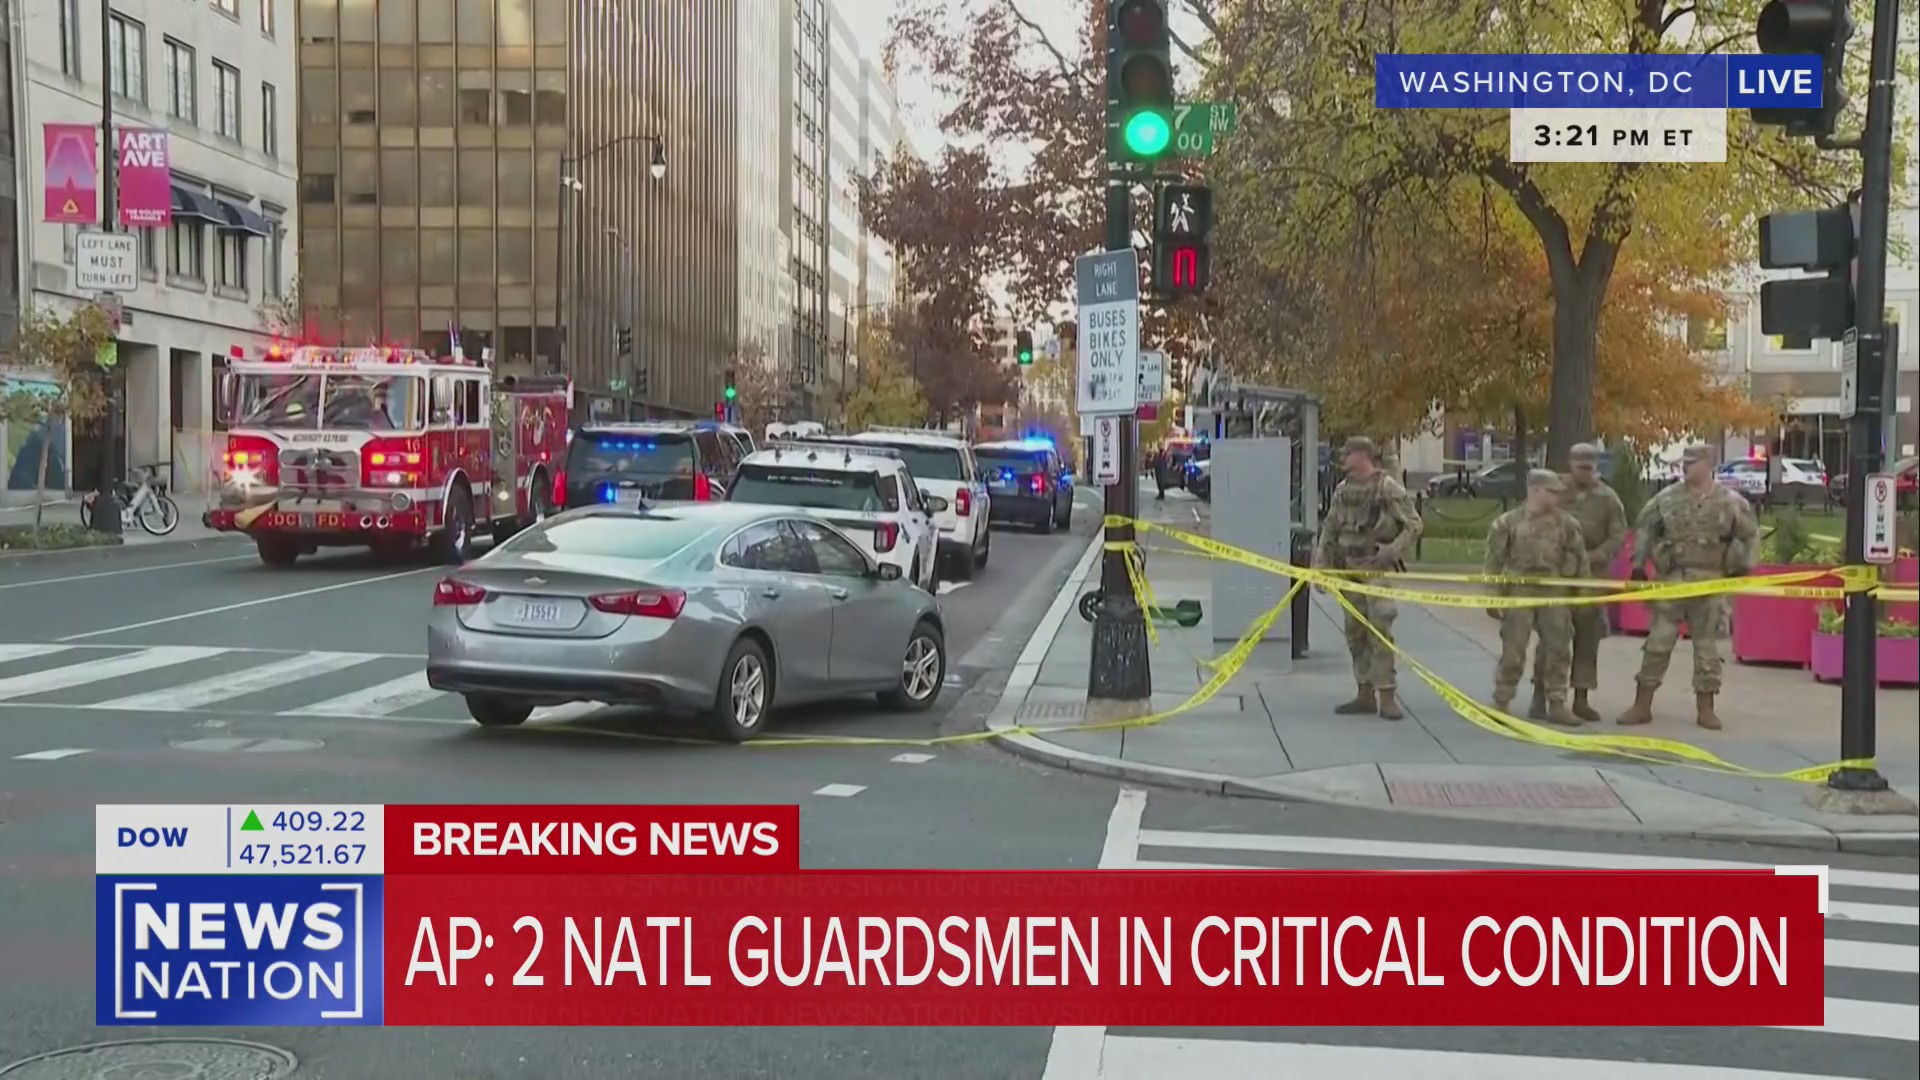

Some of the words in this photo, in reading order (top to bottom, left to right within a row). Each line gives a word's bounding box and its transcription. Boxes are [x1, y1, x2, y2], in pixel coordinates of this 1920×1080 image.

[1210, 105, 1228, 118] ST
[1209, 117, 1229, 131] NW
[123, 133, 165, 149] ART
[123, 151, 165, 167] AVE
[82, 239, 104, 249] LEFT
[108, 241, 131, 251] LANE
[90, 256, 124, 268] MUST
[1093, 261, 1117, 278] RIGHT
[82, 273, 106, 283] TURN
[110, 274, 132, 285] LEFT
[1095, 282, 1117, 297] LANE
[1089, 309, 1126, 329] BUSES
[1089, 329, 1126, 349] BIKES
[1090, 350, 1124, 368] ONLY
[274, 512, 295, 525] DC
[318, 513, 339, 526] FD
